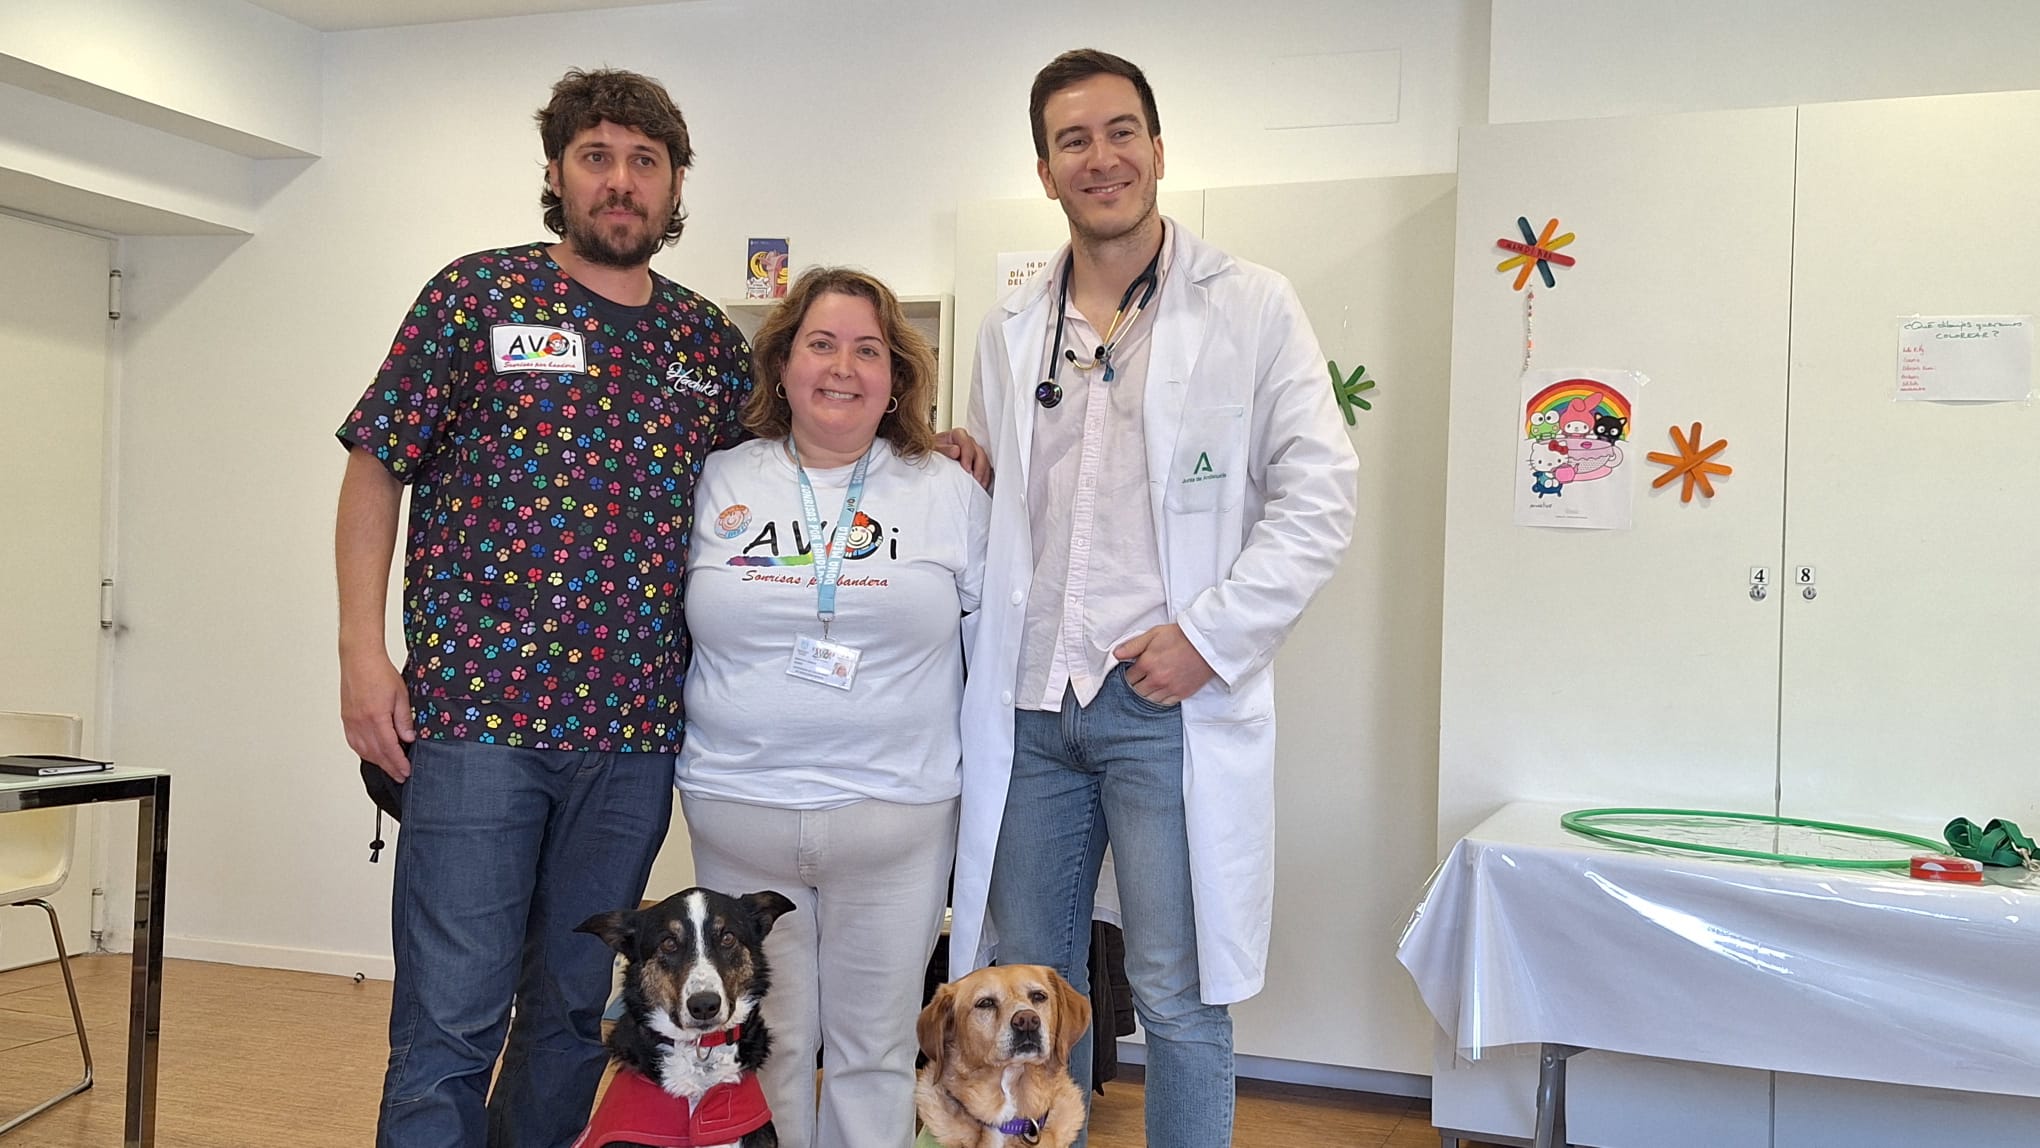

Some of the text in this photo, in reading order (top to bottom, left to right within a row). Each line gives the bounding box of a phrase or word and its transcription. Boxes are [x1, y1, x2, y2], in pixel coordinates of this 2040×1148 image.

[1010, 269, 1024, 278] DÍA
[666, 362, 719, 397] Hachiko
[742, 570, 801, 586] Sonrisas
[836, 574, 889, 587] bandera
[1754, 568, 1765, 582] 4
[1801, 567, 1811, 582] 8
